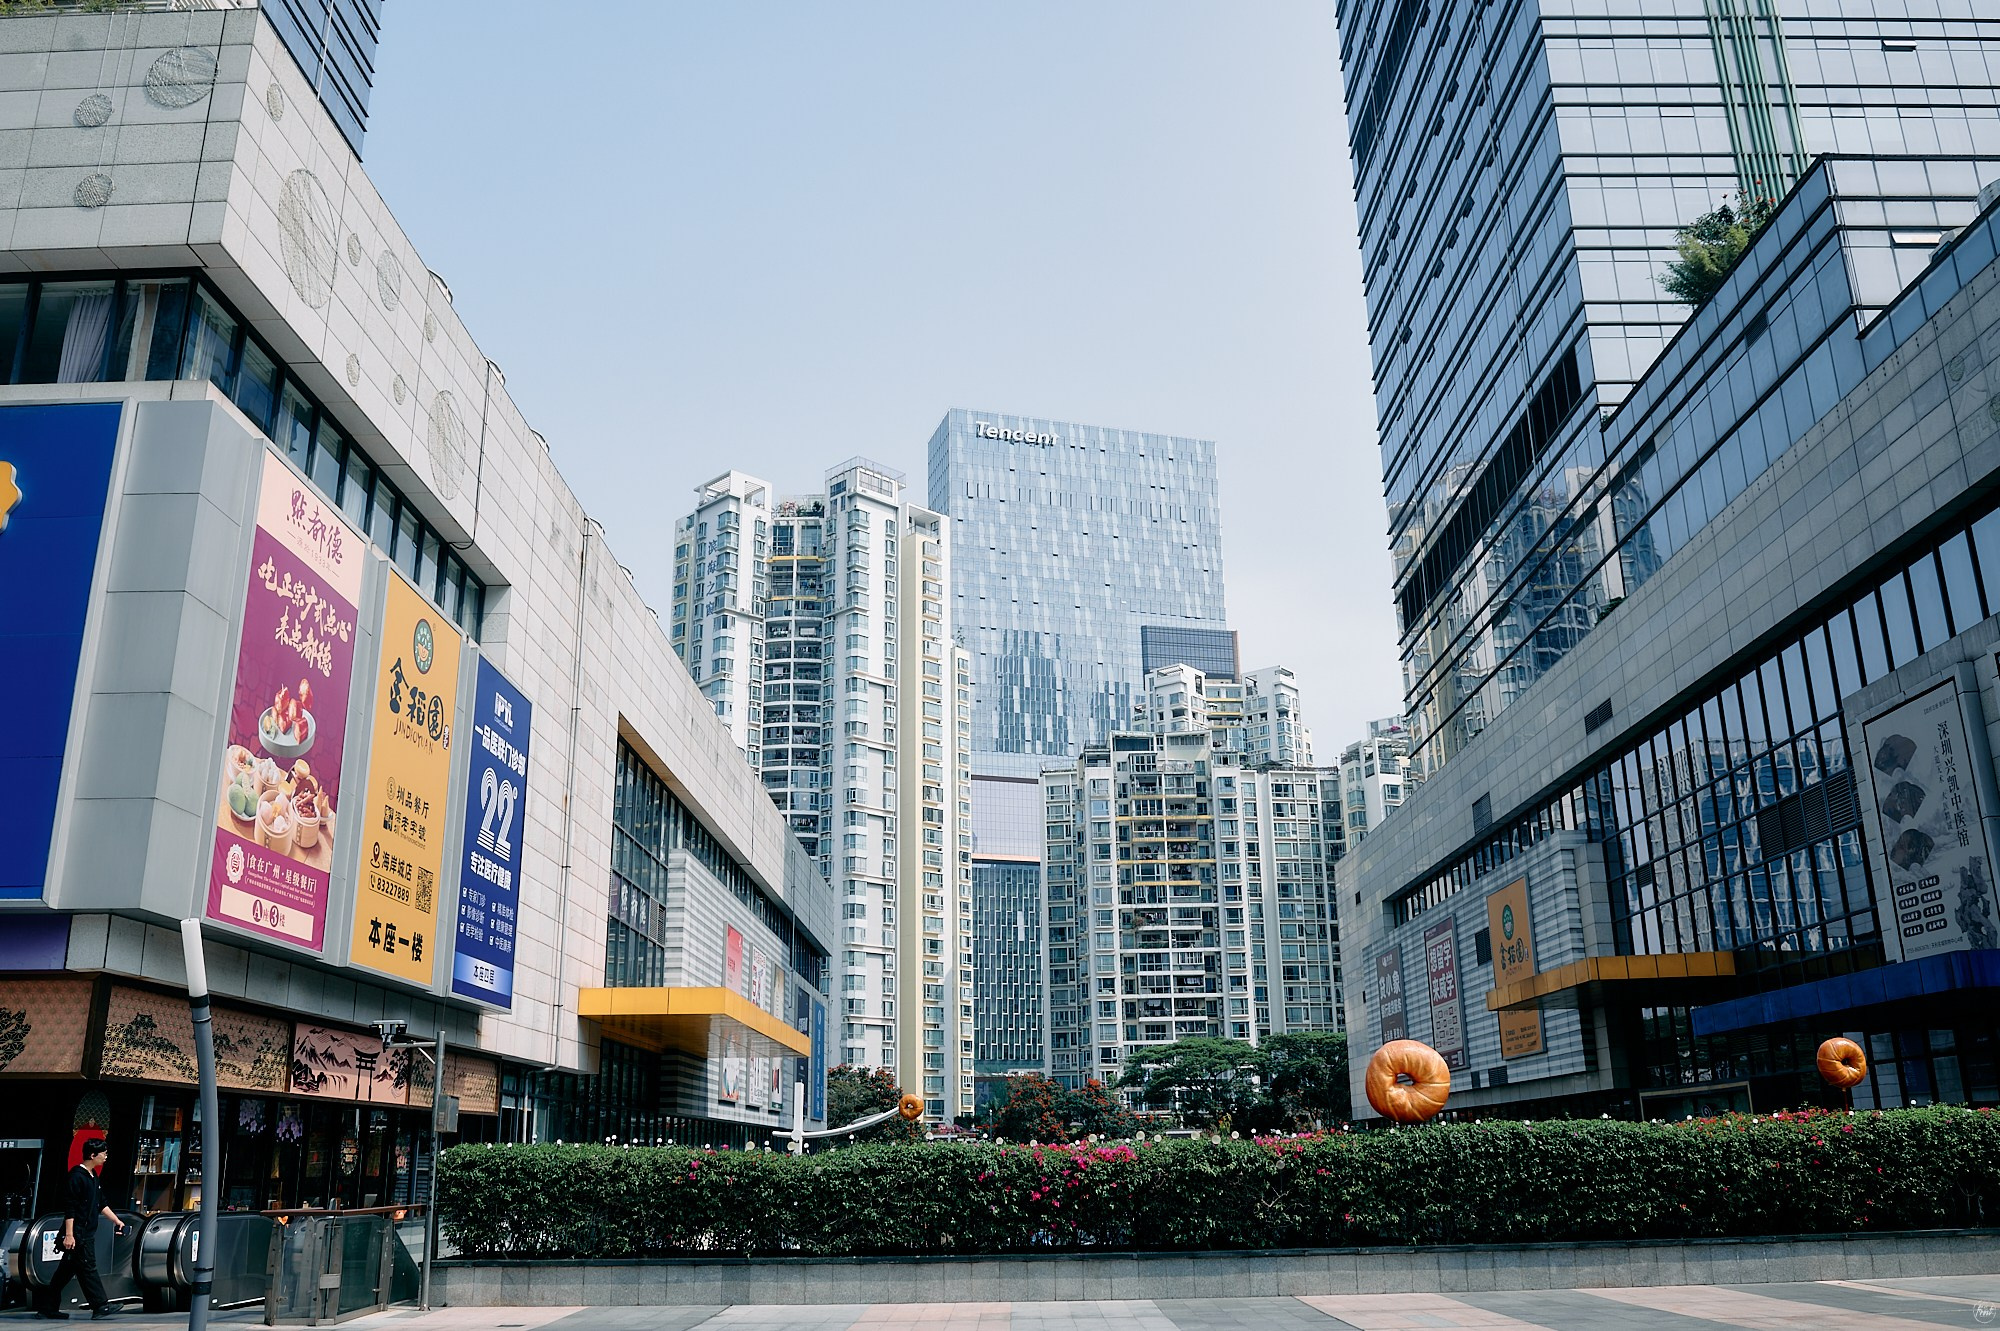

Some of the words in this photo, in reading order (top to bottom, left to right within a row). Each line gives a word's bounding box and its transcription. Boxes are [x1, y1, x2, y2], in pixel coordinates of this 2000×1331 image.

[976, 420, 1060, 445] Tencent
[475, 724, 526, 777] 一品医联门诊部
[1937, 719, 1970, 849] 深圳兴凯中医馆
[396, 785, 430, 820] 圳品餐厅
[382, 850, 413, 882] 海岸城店
[470, 851, 512, 891] 专注医疗健康
[377, 875, 410, 902] 83227889
[368, 916, 424, 963] 本座一楼
[1429, 941, 1452, 973] 想留学
[473, 964, 495, 985] 本座四层
